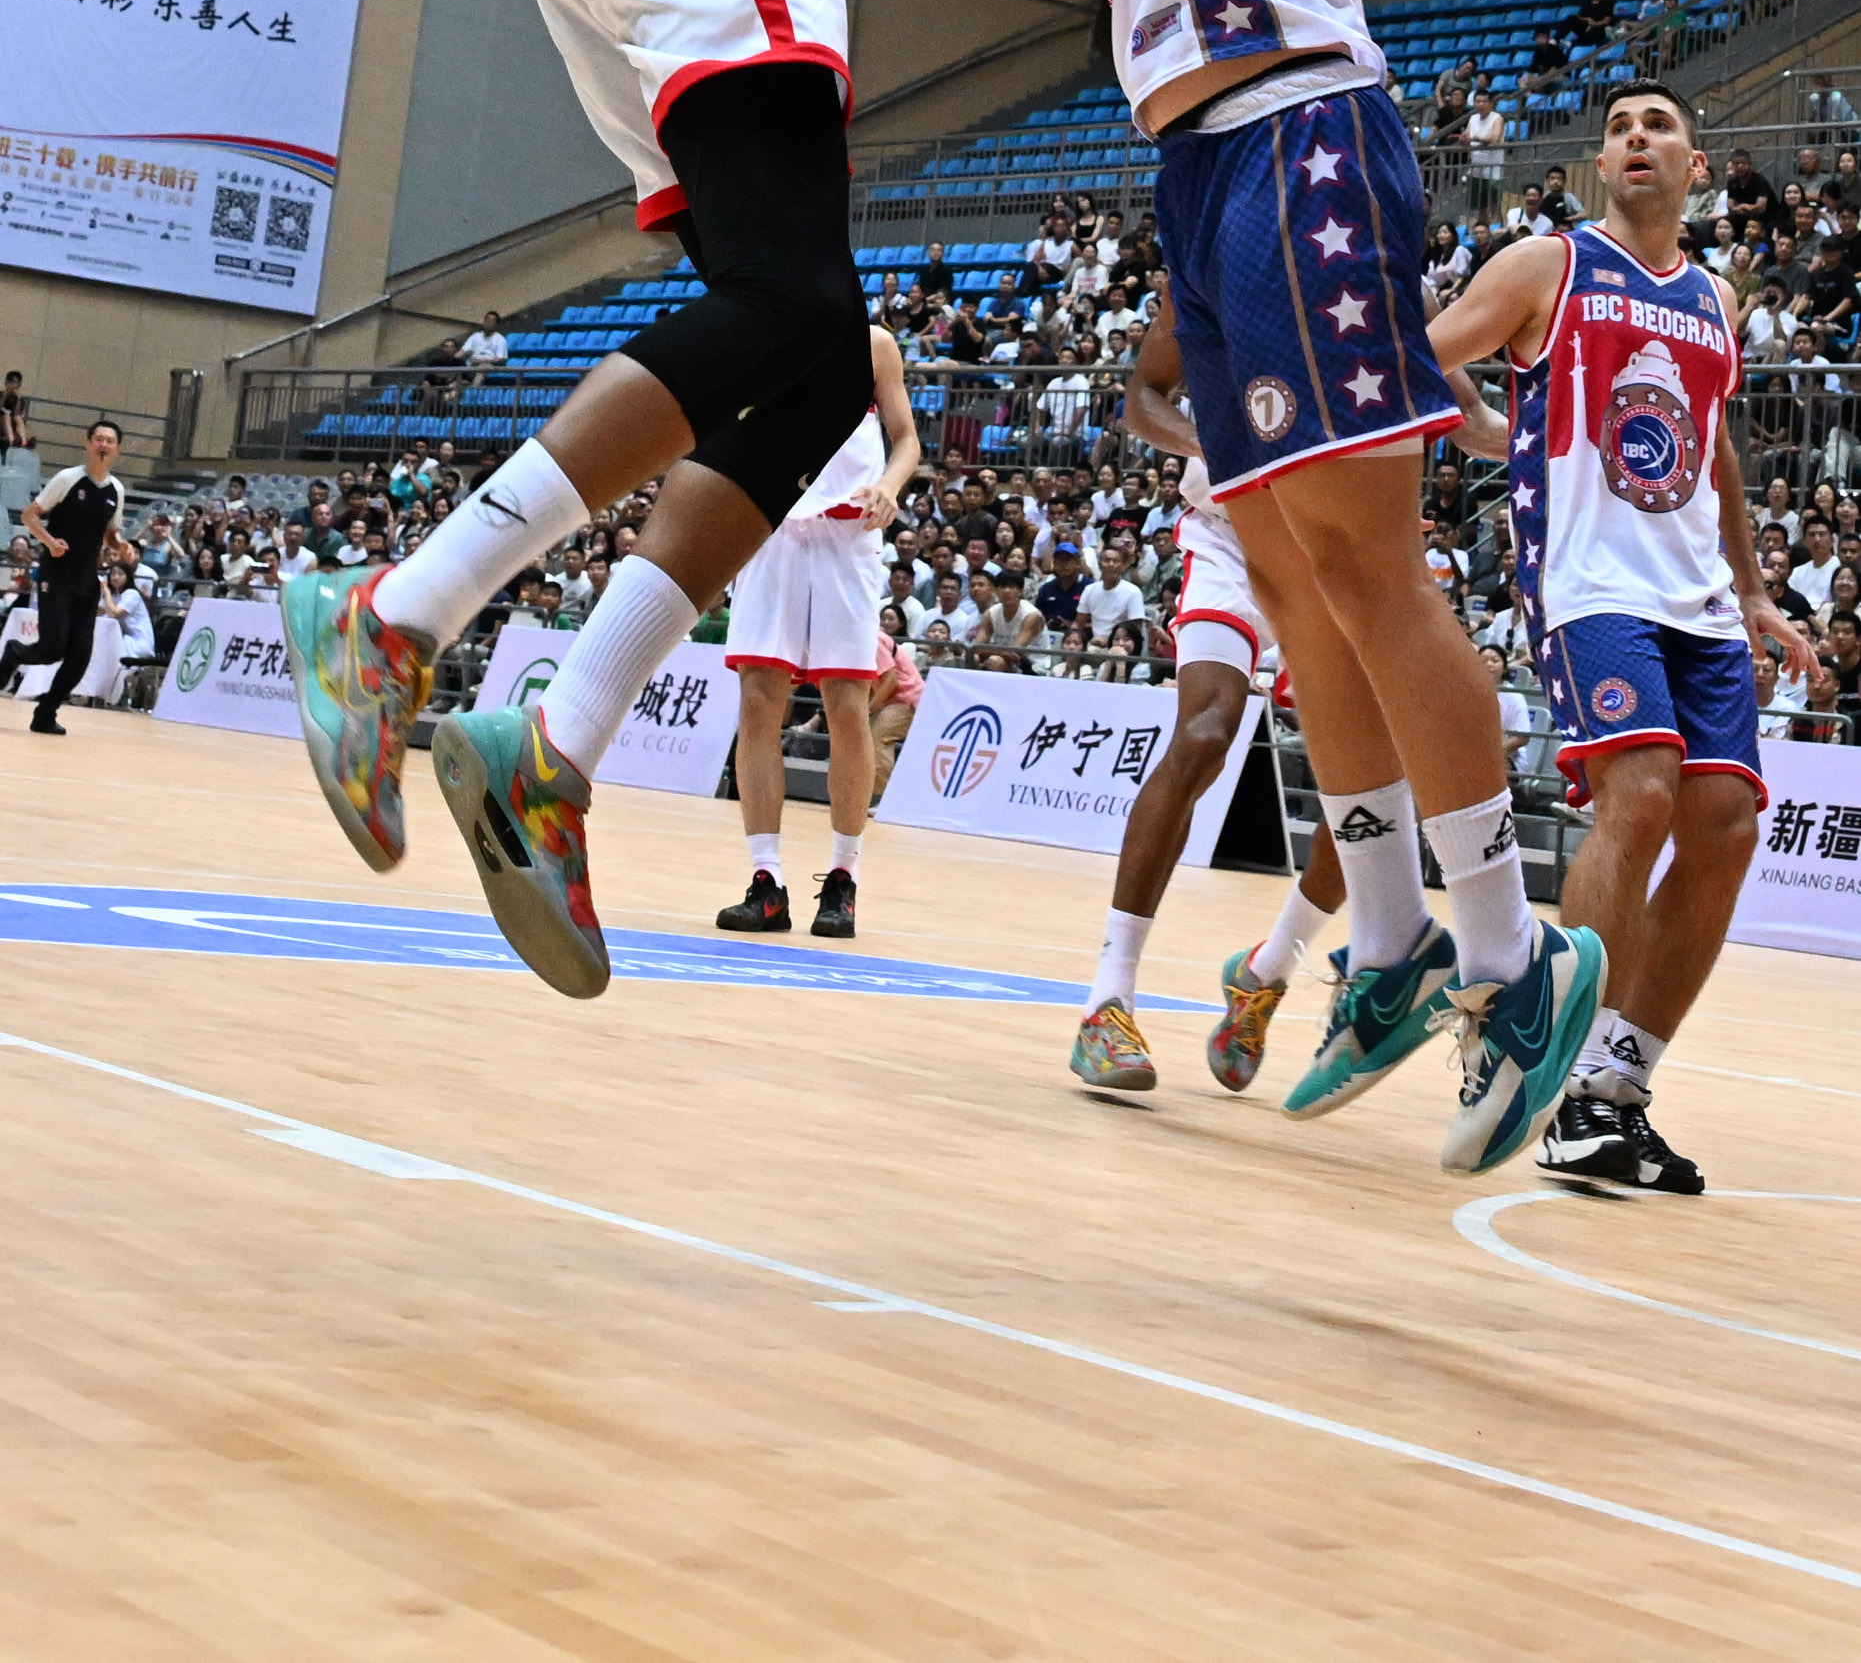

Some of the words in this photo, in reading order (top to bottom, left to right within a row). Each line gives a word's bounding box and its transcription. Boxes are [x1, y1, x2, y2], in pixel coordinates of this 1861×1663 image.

[1697, 293, 1717, 316] 10
[1581, 294, 1624, 322] IBC
[1629, 298, 1726, 356] BEOGRAD
[1622, 442, 1650, 459] IBC
[642, 732, 691, 755] CCIG
[1020, 714, 1162, 786] 伊宁国
[1009, 784, 1090, 812] YINNING
[1333, 818, 1397, 842] PEAK
[1767, 799, 1861, 861] 新疆
[1759, 868, 1832, 891] XINJIANG
